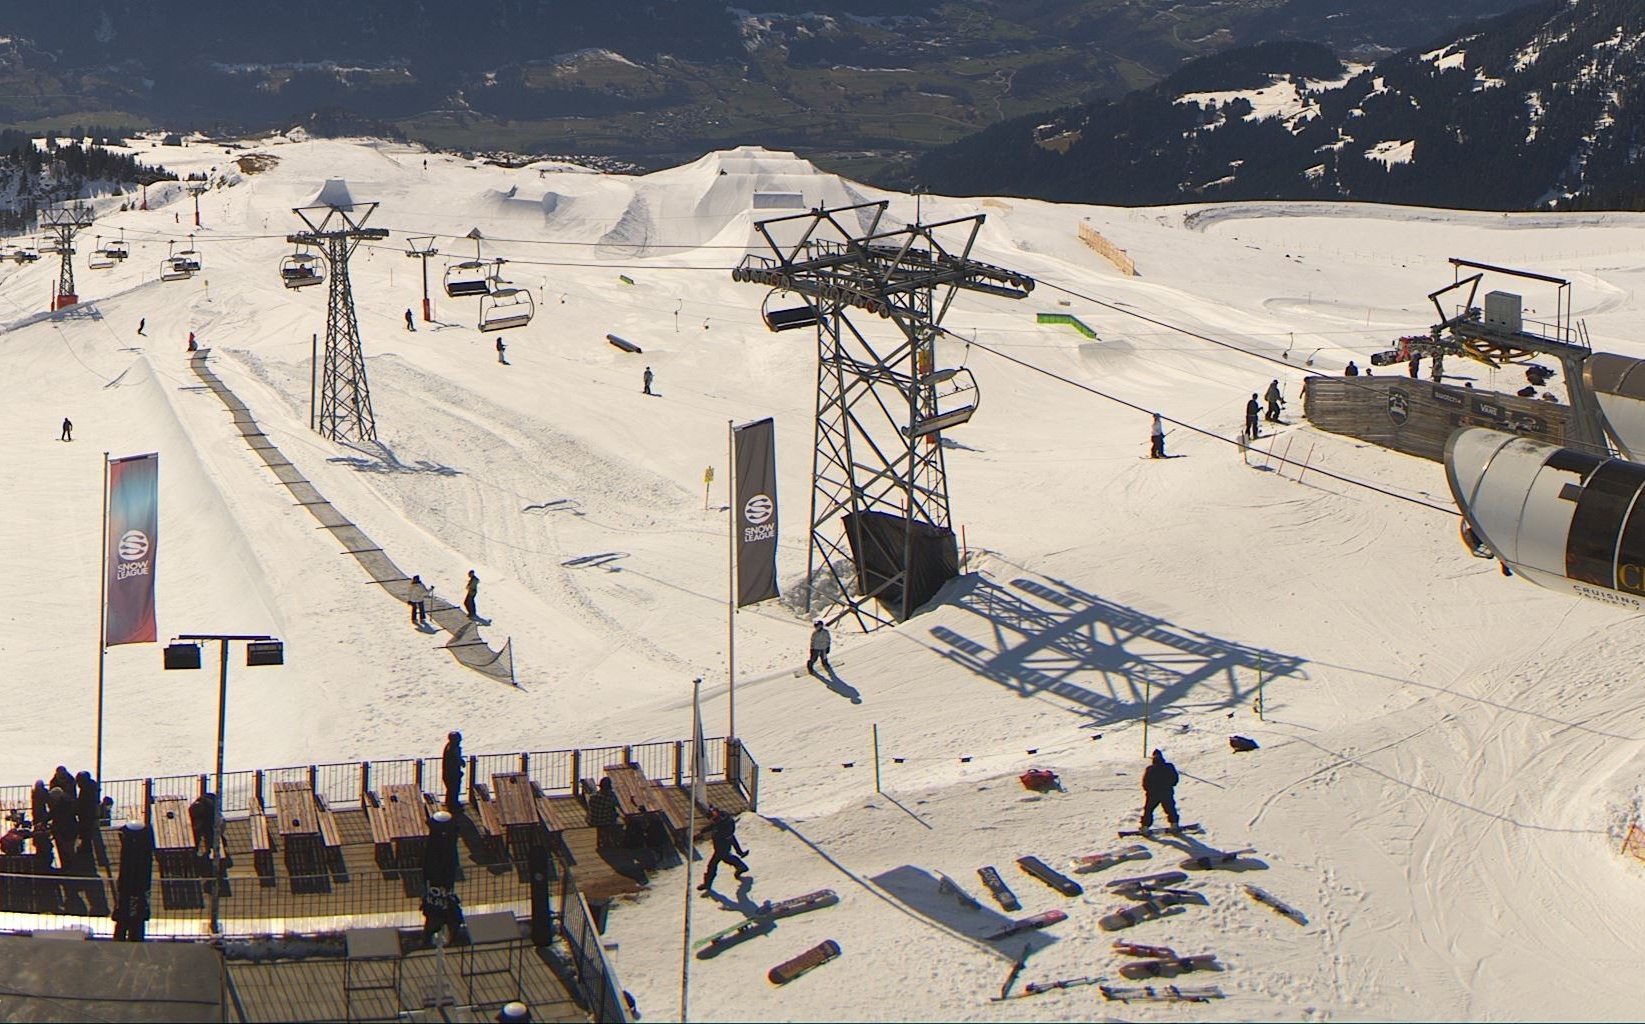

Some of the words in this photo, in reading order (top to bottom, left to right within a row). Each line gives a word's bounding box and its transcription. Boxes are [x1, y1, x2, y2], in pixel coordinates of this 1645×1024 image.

[745, 523, 775, 536] SNOW
[745, 531, 775, 542] LEAGUE
[117, 560, 149, 573] SNOW
[117, 568, 149, 580] LEAGUE
[1573, 584, 1640, 606] CRUISING
